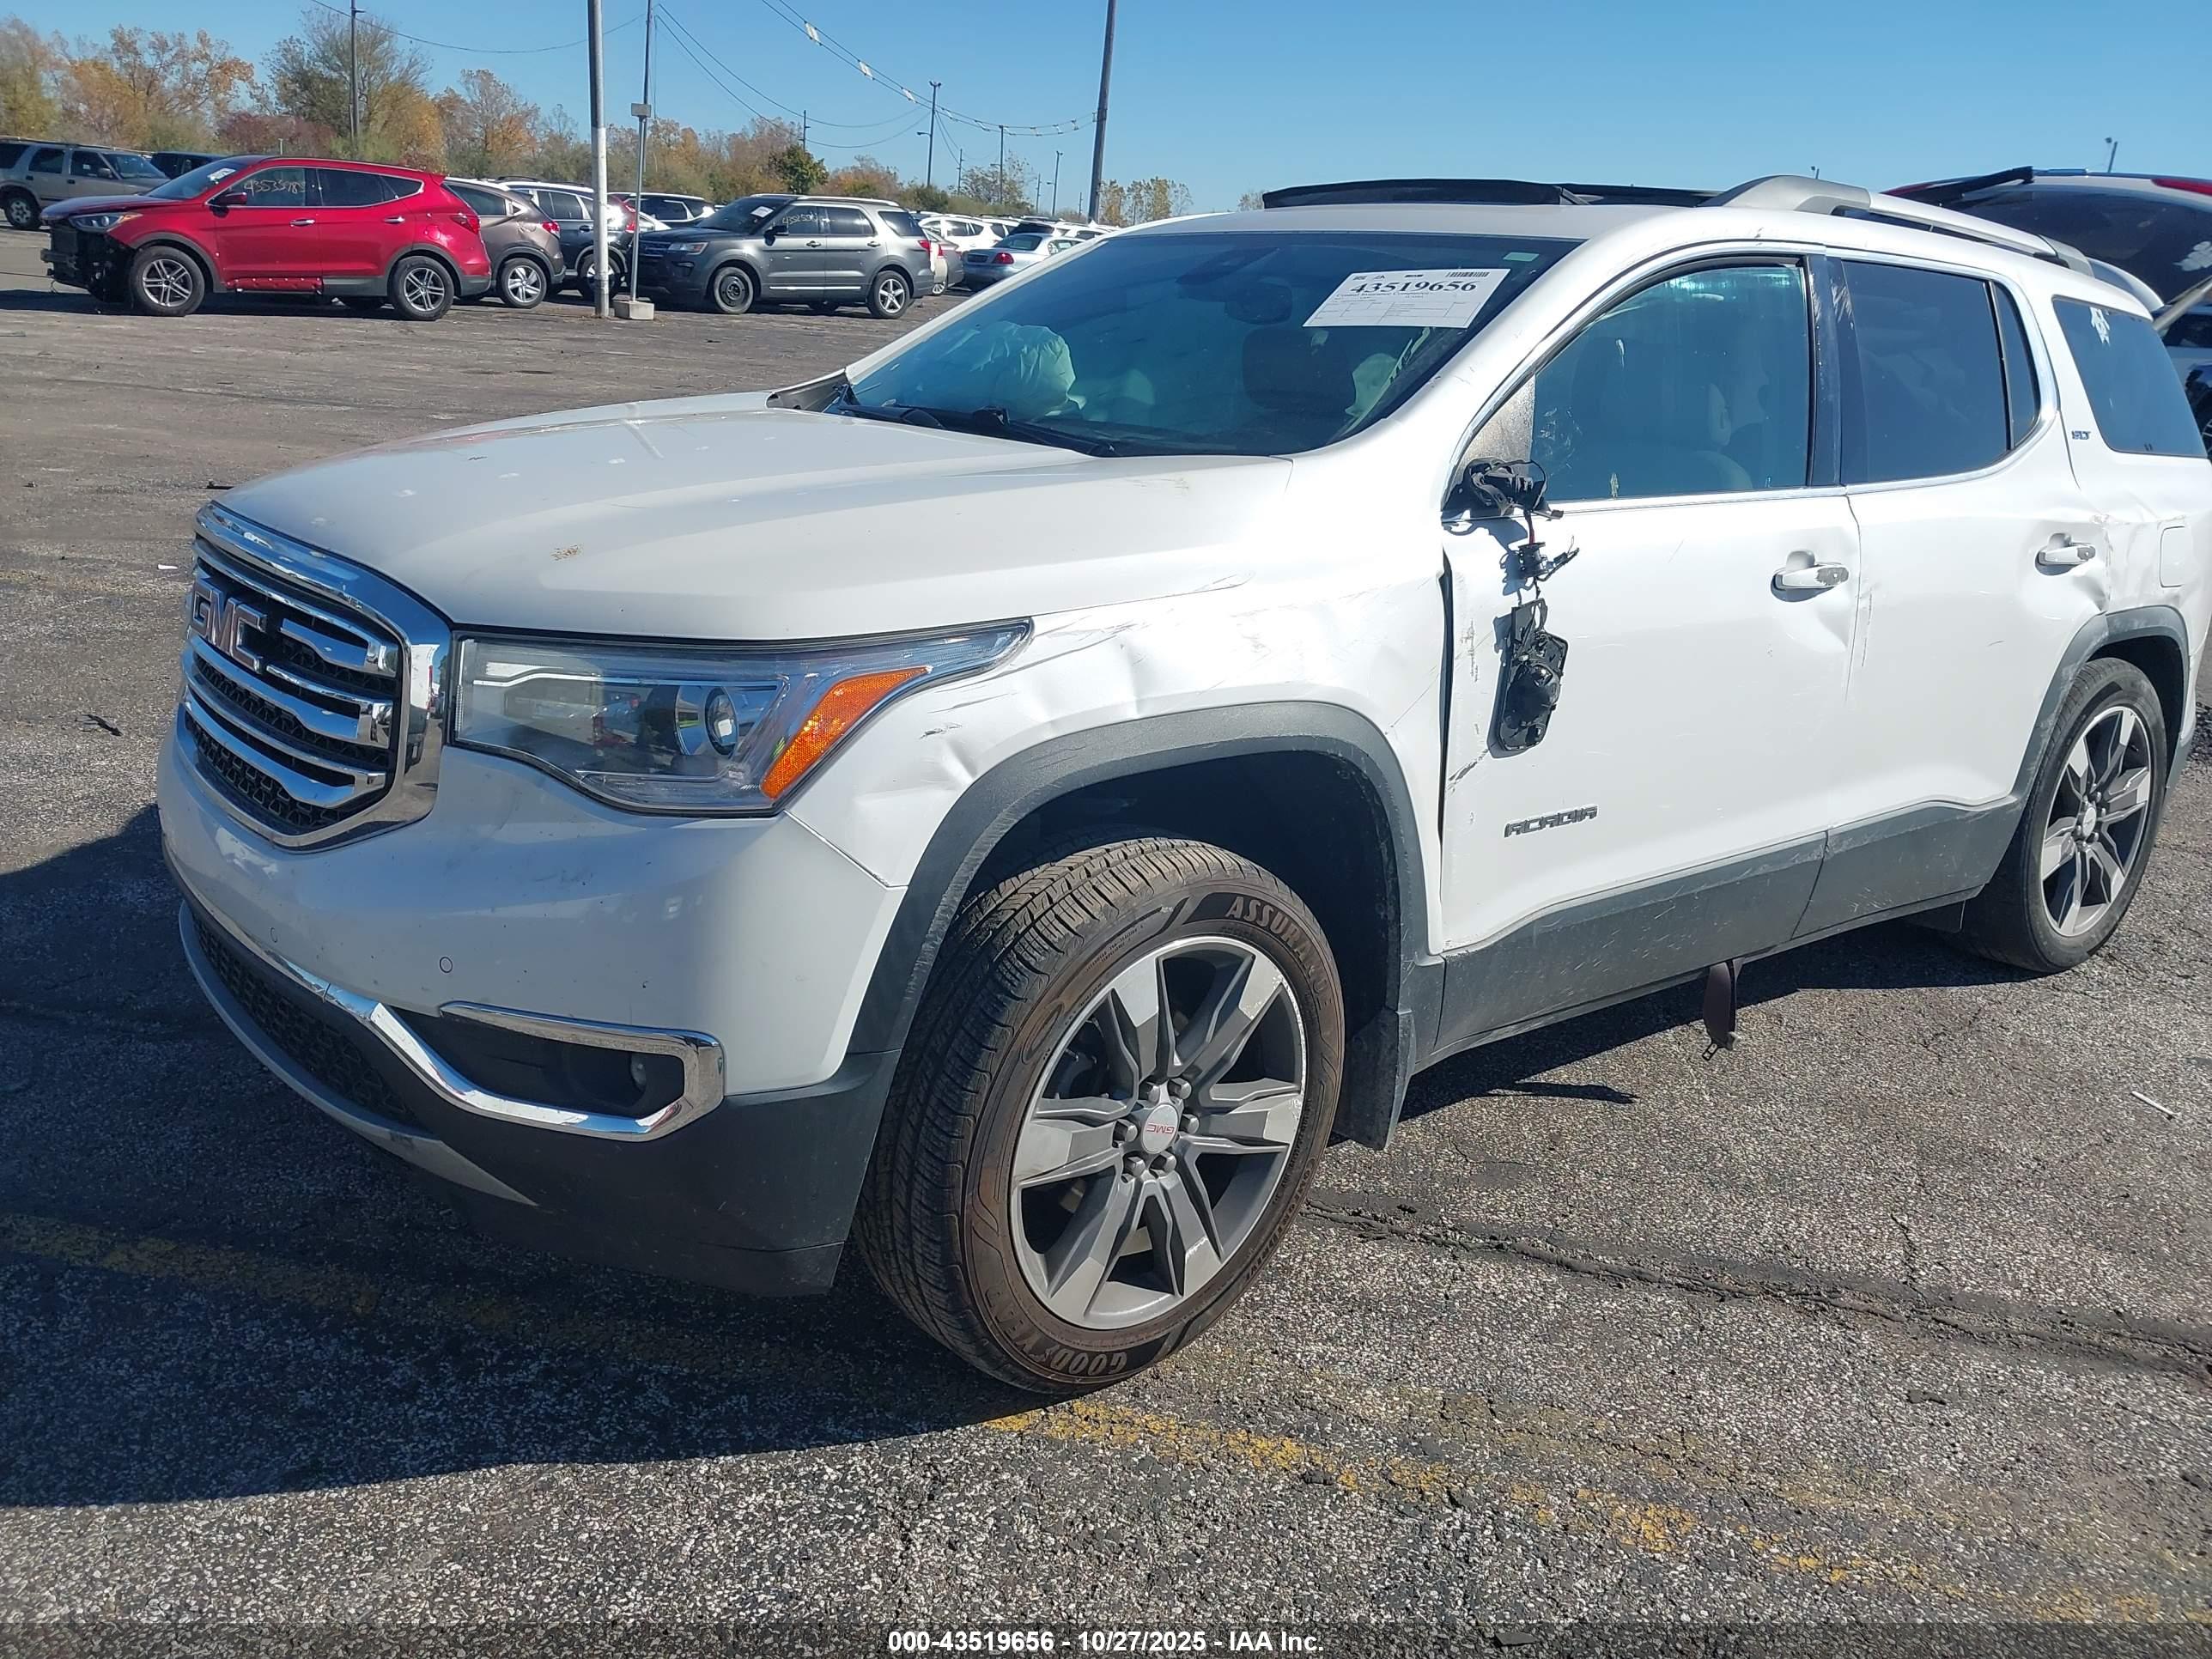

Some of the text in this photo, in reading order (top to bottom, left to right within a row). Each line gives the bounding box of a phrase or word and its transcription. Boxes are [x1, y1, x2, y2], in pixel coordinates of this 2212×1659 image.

[1351, 281, 1476, 293] 43519656
[191, 578, 267, 674] GMC
[1504, 805, 1597, 838] ACADIA
[1146, 1123, 1175, 1134] GMC
[985, 1287, 1127, 1376] GOODYEAR
